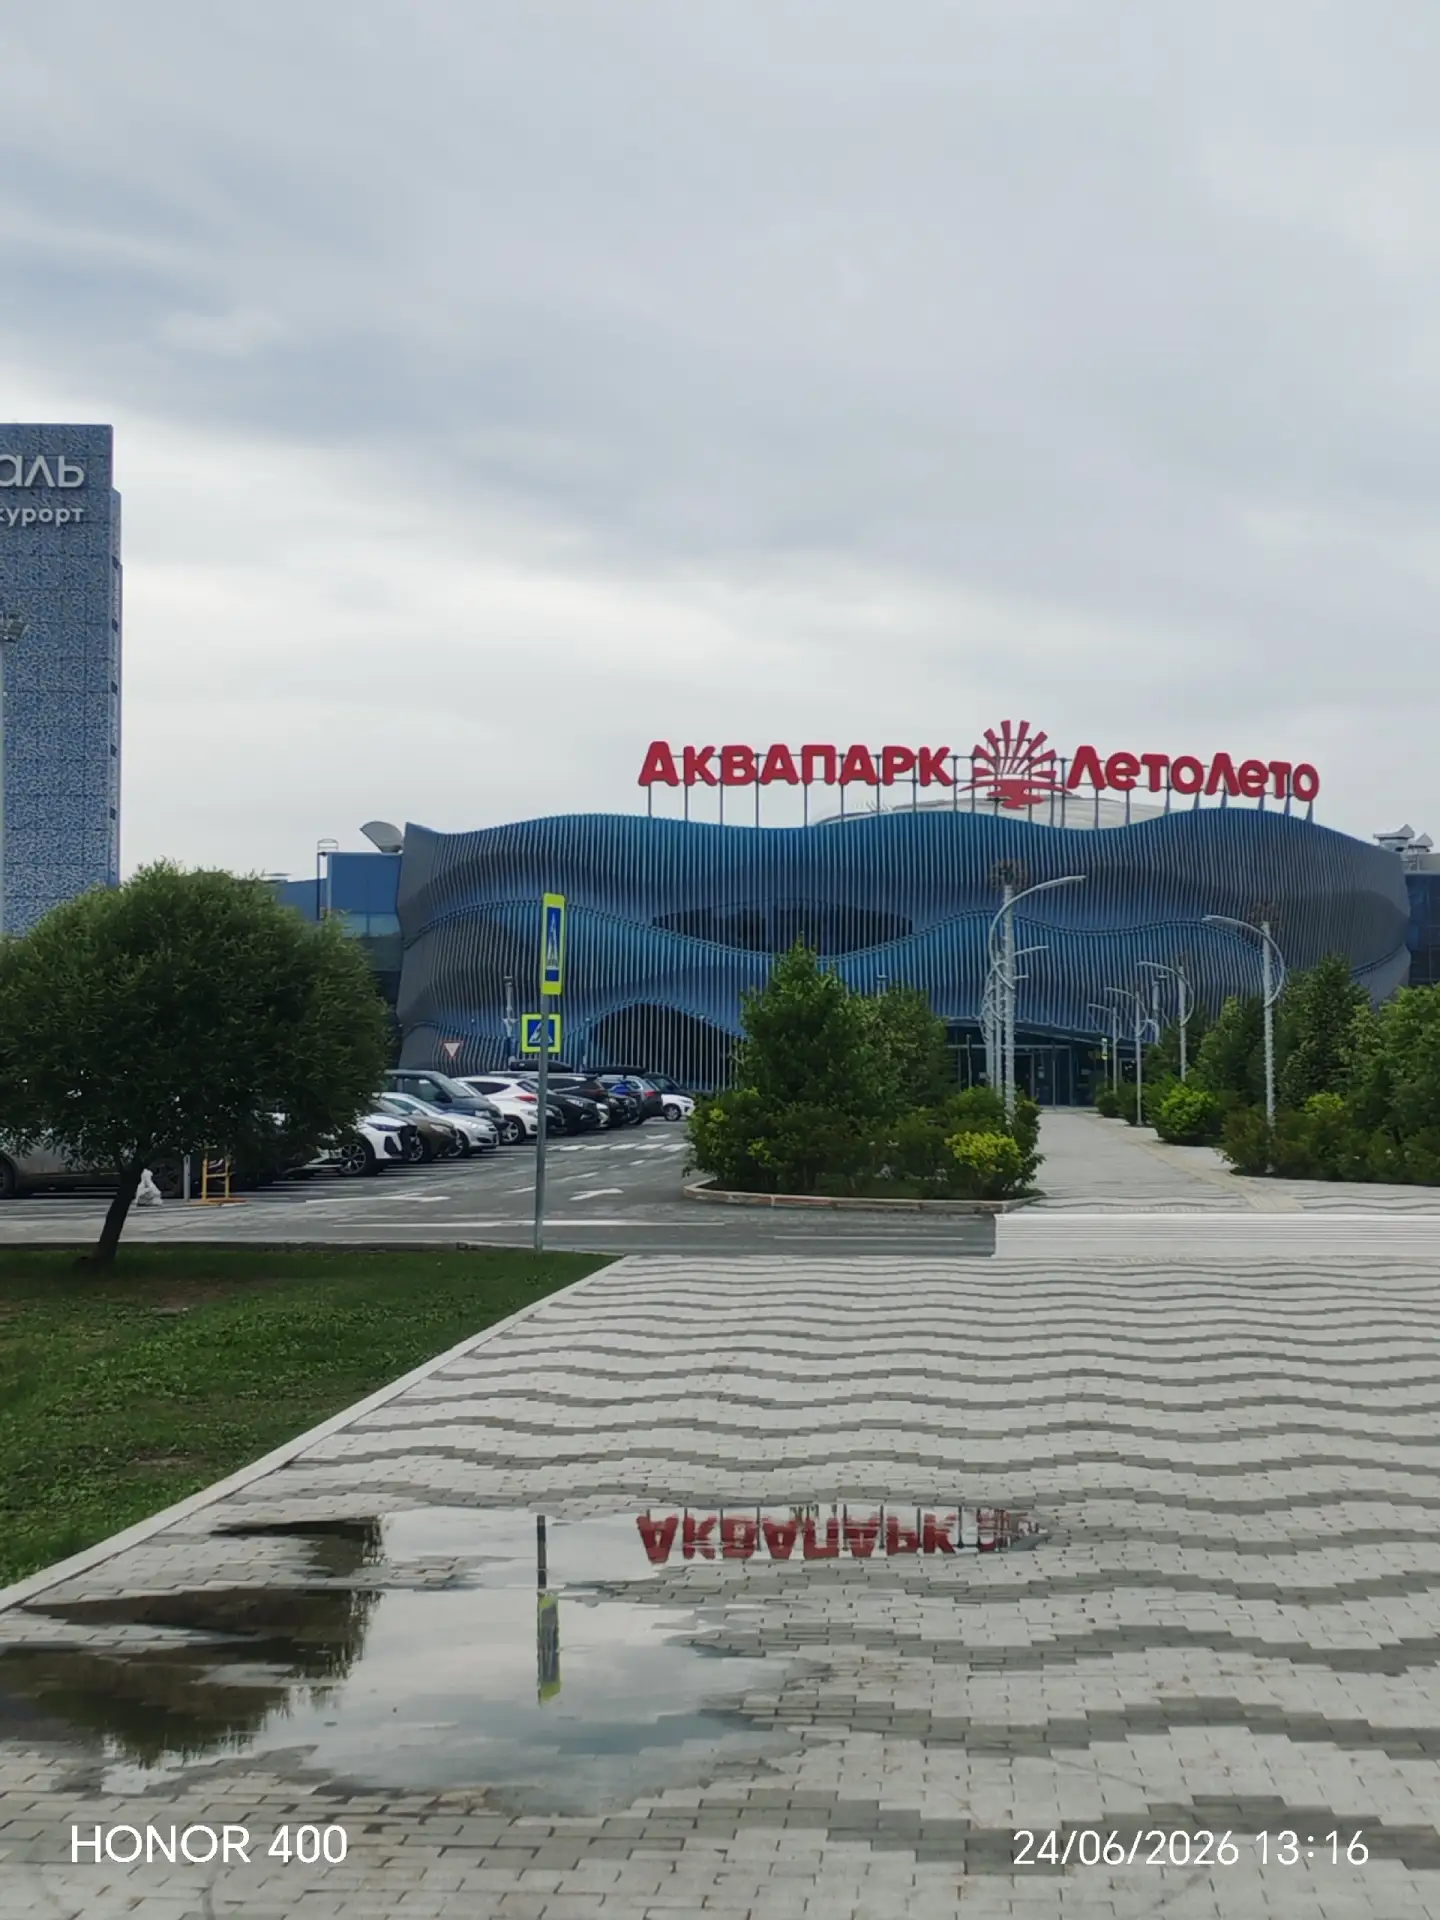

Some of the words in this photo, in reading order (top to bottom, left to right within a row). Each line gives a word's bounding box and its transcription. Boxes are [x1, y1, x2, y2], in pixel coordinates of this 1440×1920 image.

[0, 454, 84, 487] аль
[638, 741, 951, 787] АКВАПАРК
[1066, 745, 1320, 801] ЛетоЛето
